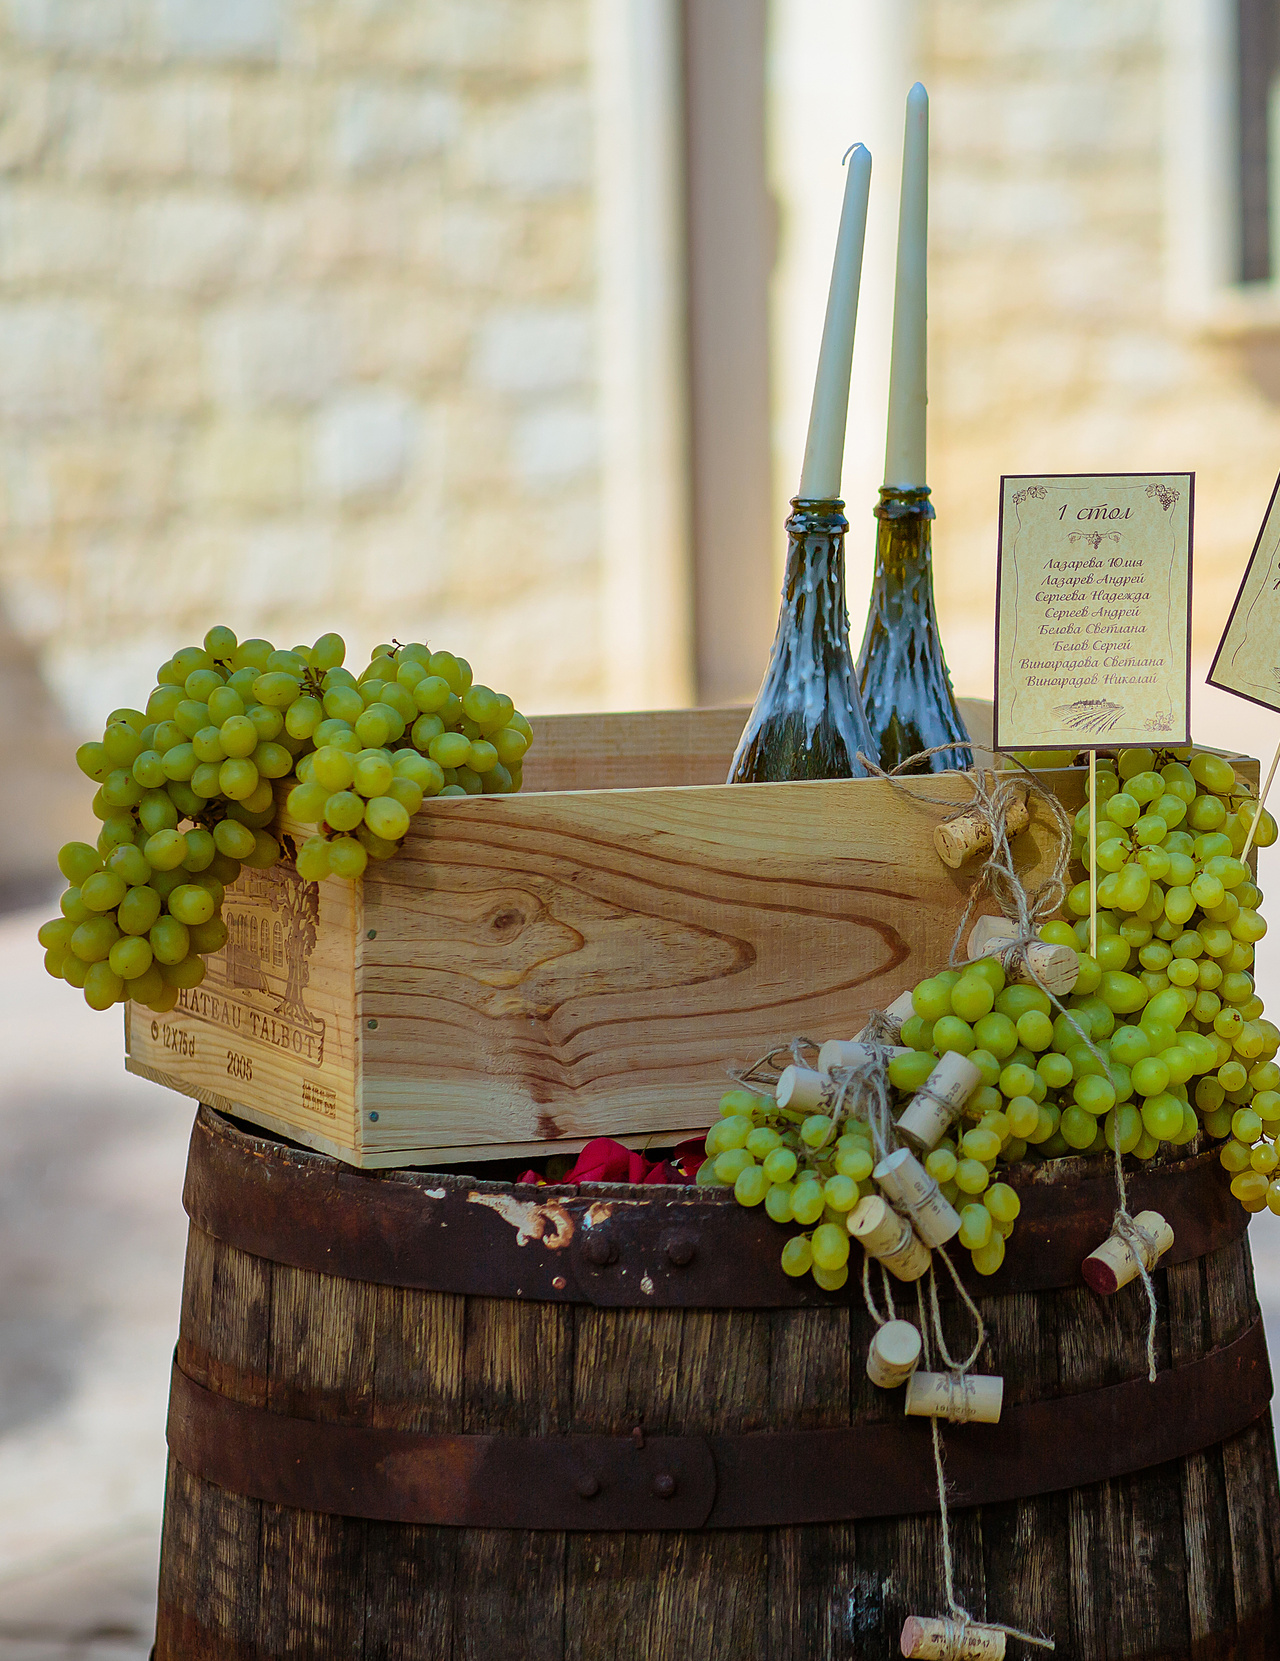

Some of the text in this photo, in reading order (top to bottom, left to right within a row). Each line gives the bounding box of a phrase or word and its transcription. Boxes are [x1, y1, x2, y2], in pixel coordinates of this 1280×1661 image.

[1058, 503, 1134, 521] 1 стол
[1042, 557, 1145, 572] Лазарева Юлия
[1040, 573, 1146, 588] Лазарев Андрей
[1035, 590, 1151, 604] Сергеева Надежда
[1045, 606, 1140, 621] Сергеев Андрей
[1038, 622, 1147, 635] Белова Светлана
[1053, 639, 1132, 653] Белов Сергей
[1019, 656, 1165, 672] Виноградова Светлана
[1025, 672, 1158, 689] Виноградов Николай
[178, 988, 315, 1059] HATEAU TALBOT
[227, 1050, 254, 1082] 2005
